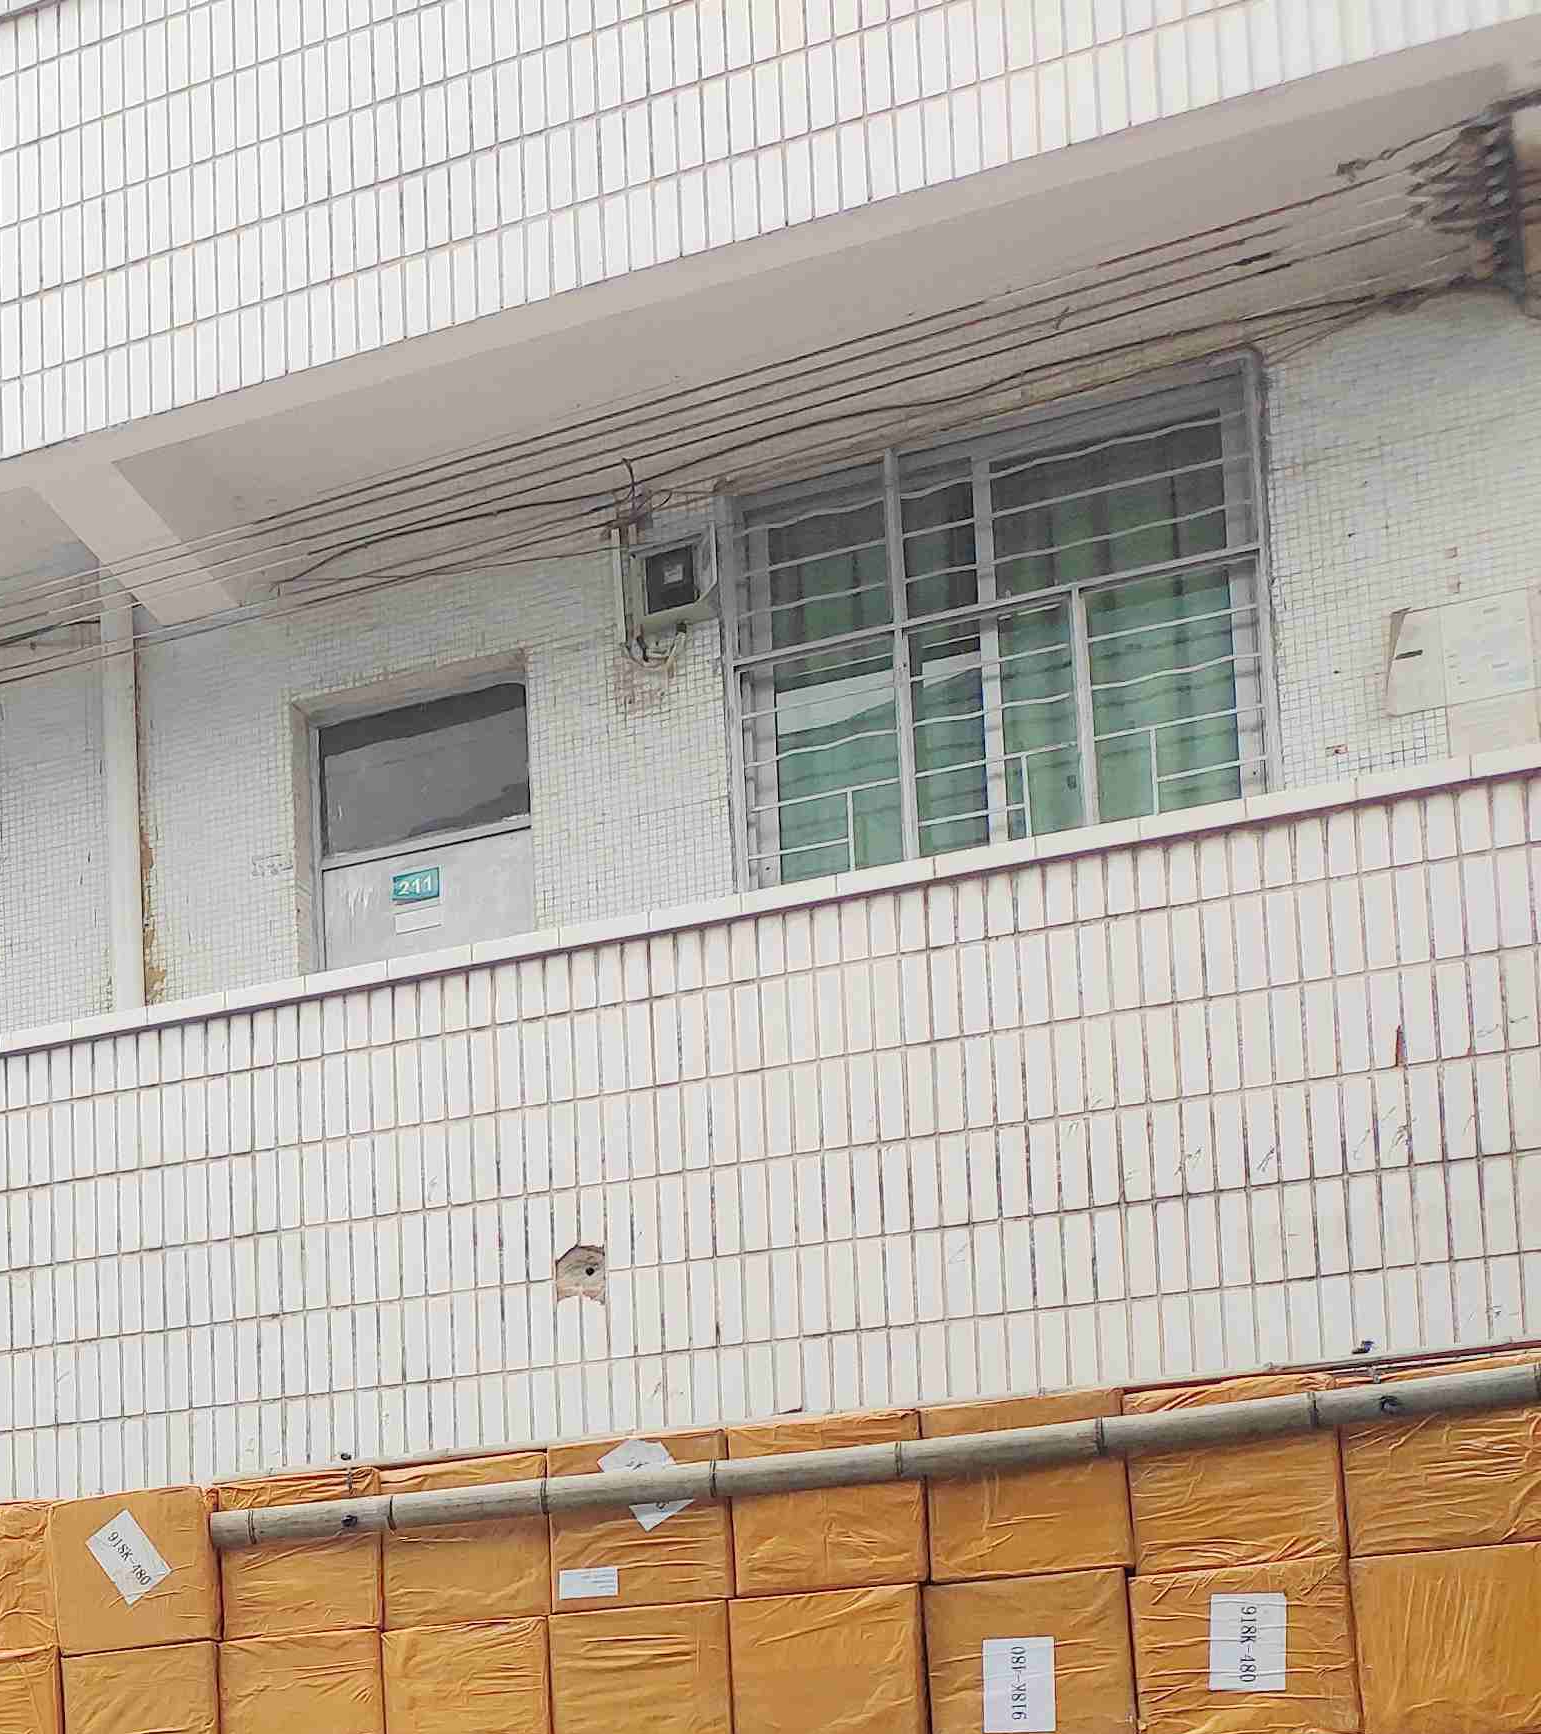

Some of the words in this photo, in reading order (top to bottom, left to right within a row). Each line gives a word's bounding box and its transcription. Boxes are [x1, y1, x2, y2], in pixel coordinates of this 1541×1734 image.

[399, 877, 433, 896] 211
[107, 1531, 152, 1587] 918K-480
[1238, 1606, 1258, 1684] 918K-480
[1010, 1645, 1027, 1722] 918K-480
